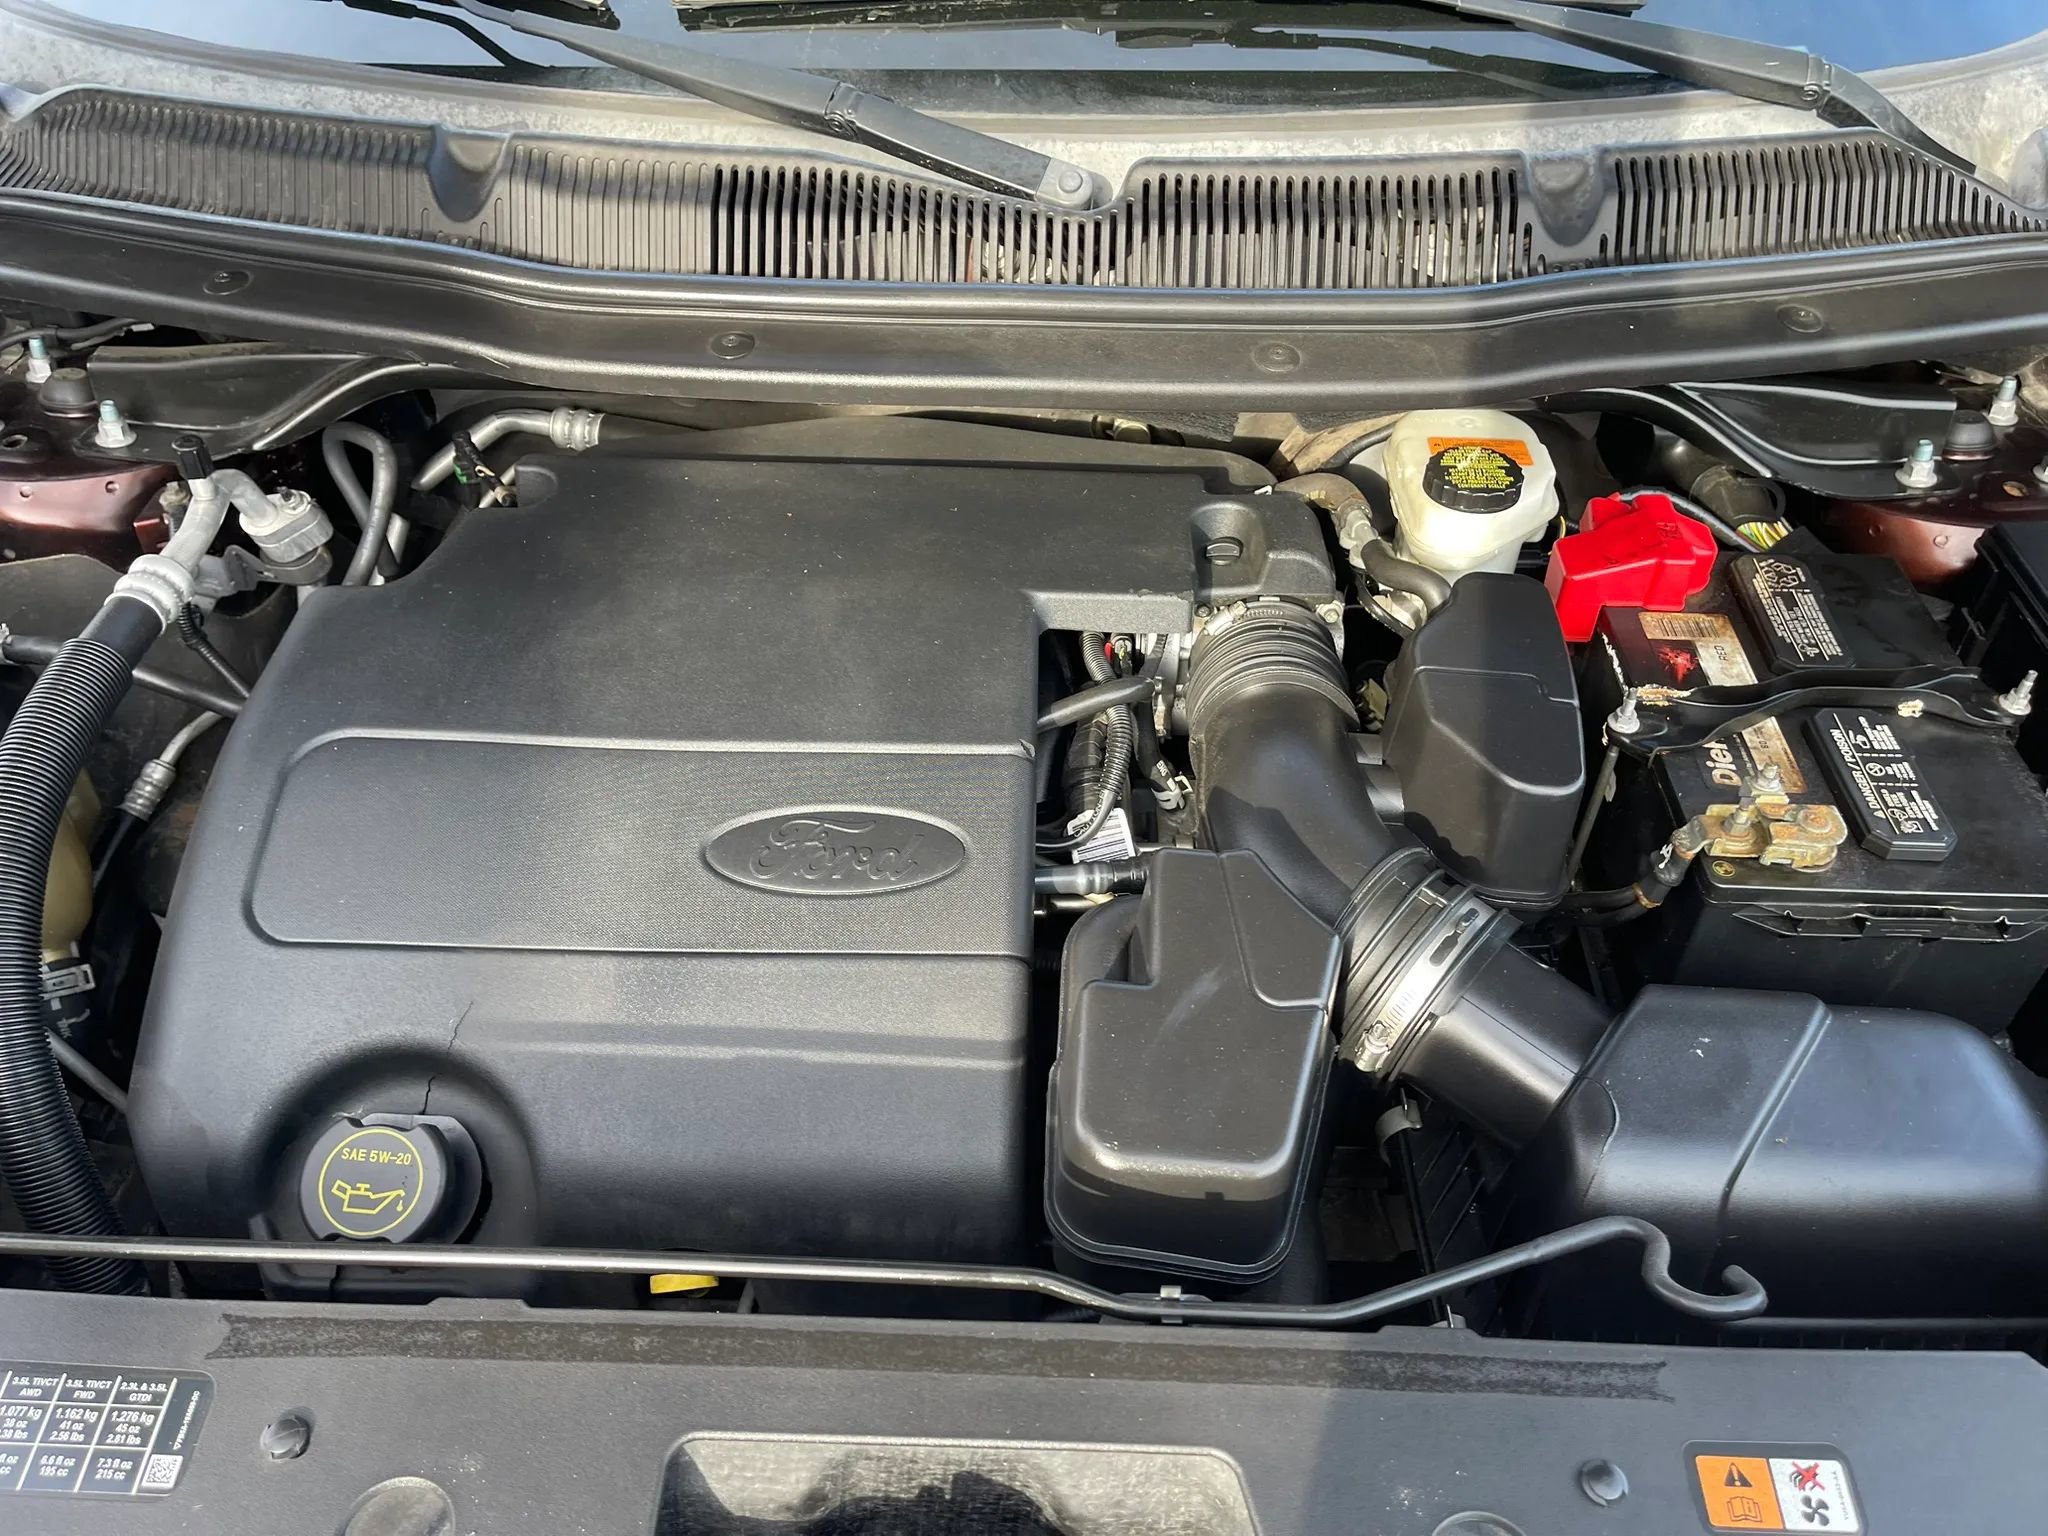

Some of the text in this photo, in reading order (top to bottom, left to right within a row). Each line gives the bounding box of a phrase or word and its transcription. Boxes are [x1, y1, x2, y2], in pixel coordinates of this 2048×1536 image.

[1829, 729, 1857, 762] POISON
[1851, 770, 1881, 809] DANGER
[749, 818, 925, 881] Ford
[341, 1147, 413, 1166] SAE 5W-20
[120, 1381, 139, 1391] 2.3L
[140, 1382, 149, 1391] &
[19, 1388, 43, 1397] AWD
[73, 1390, 96, 1400] FWD
[0, 1404, 43, 1420] 1.077 kg
[55, 1407, 99, 1423] 1.162 kg
[111, 1410, 155, 1425] 1.276 kg
[3, 1418, 28, 1429] 38 oz
[59, 1420, 85, 1431] 41 oz
[115, 1423, 141, 1434] 45 oz
[0, 1429, 29, 1440] .38 lbs
[69, 1431, 85, 1442] lbs
[127, 1434, 142, 1445] lbs
[6, 1455, 20, 1465] oz
[64, 1457, 76, 1467] oz
[97, 1457, 112, 1468] 7.3
[120, 1460, 133, 1470] oz
[39, 1466, 69, 1477] 195 cc
[95, 1469, 127, 1480] 215 cc
